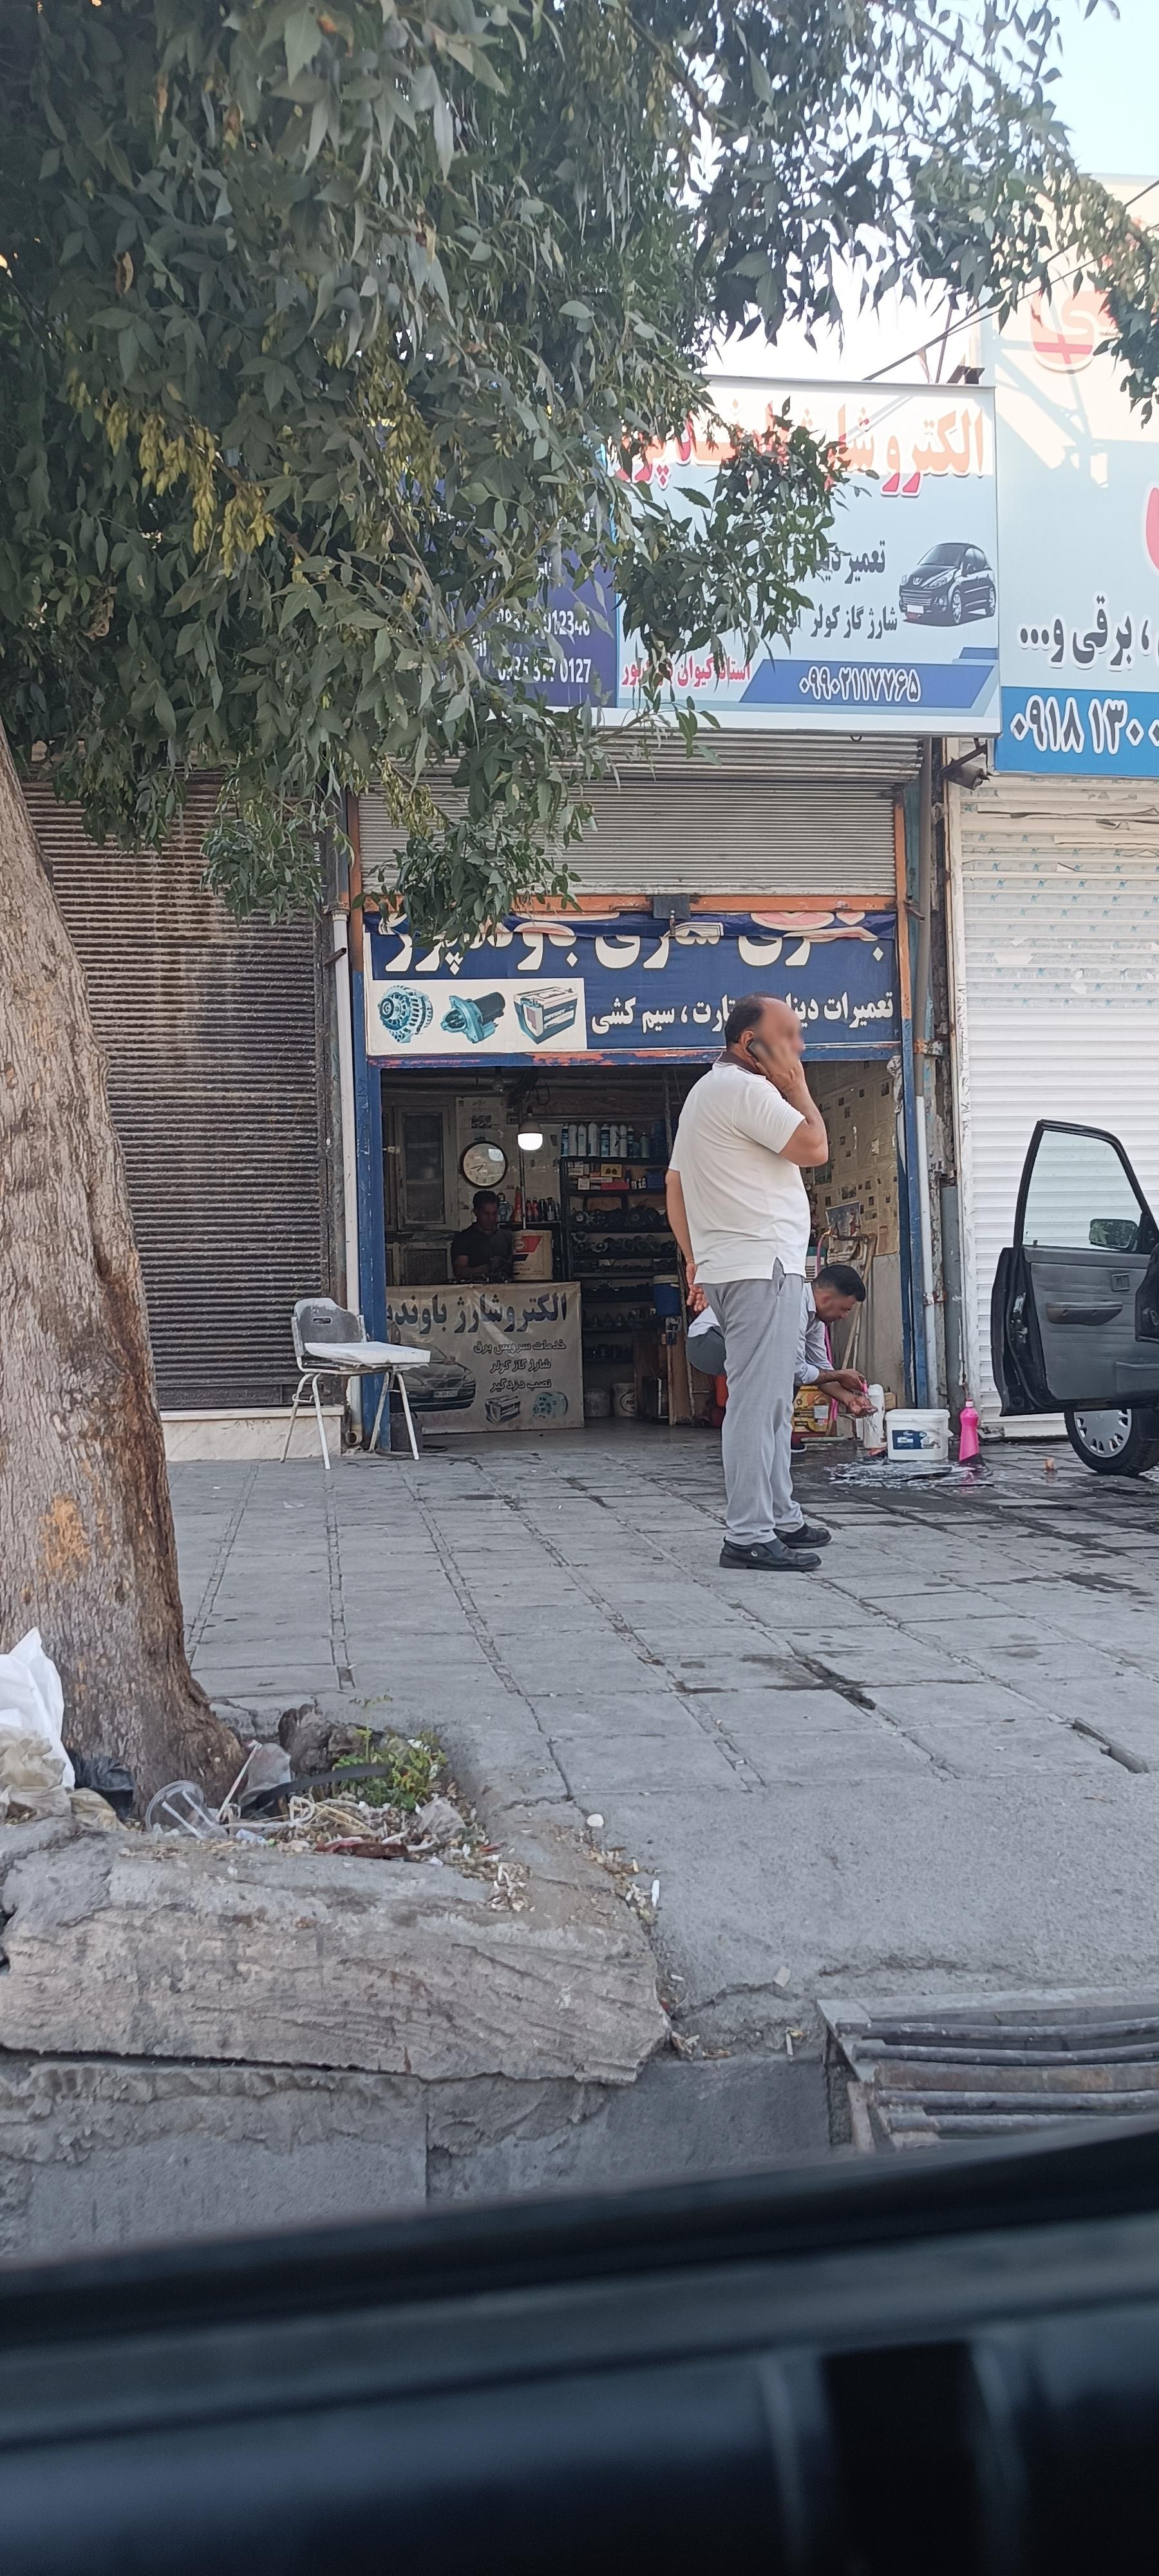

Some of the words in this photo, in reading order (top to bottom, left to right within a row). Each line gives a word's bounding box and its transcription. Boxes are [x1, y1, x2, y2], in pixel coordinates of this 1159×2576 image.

[845, 540, 885, 584] تعمیر
[810, 603, 840, 638] کولر
[843, 605, 864, 638] گاز
[867, 606, 898, 639] شارژ
[1072, 594, 1133, 666] برقی
[800, 667, 920, 701] ۰۹۹۰۲۱۱۷۷۶۵
[1011, 696, 1084, 754] ۰۹۱۸
[592, 996, 636, 1034] کشی
[642, 1007, 675, 1034] سیم
[786, 991, 819, 1028] دینا
[823, 990, 893, 1028] تعمیرات
[473, 1340, 493, 1354] برق
[494, 1343, 531, 1355] سرویس
[532, 1339, 567, 1350] خدمات
[490, 1359, 511, 1374] کولر
[528, 1358, 551, 1372] شارژ
[527, 1378, 552, 1391] نصب
